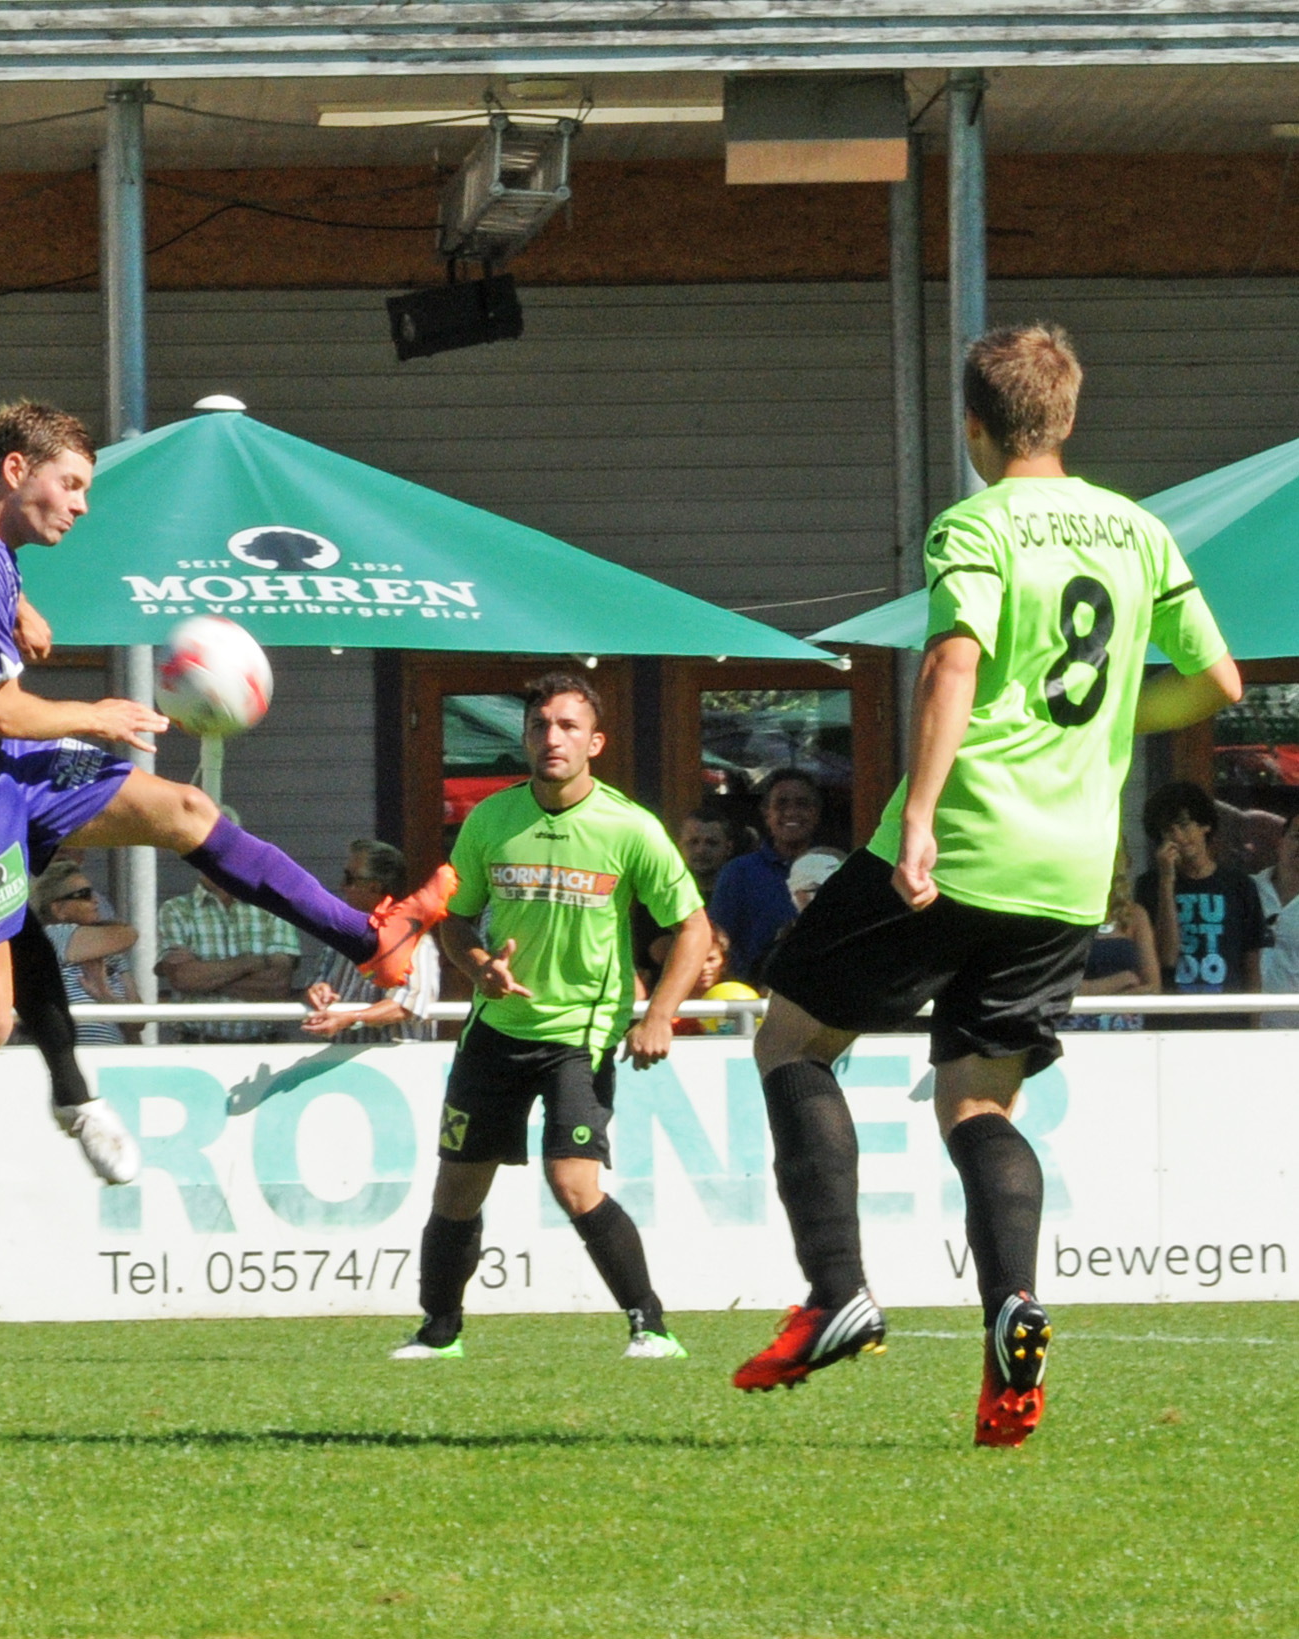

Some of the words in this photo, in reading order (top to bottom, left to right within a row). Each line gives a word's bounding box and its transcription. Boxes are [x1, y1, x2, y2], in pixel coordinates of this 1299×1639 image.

[1013, 513, 1045, 548] SC
[1048, 512, 1137, 551] FUSSACH
[176, 559, 232, 570] SEIT
[348, 561, 404, 573] 1834
[121, 574, 476, 608] MOHREN
[139, 603, 196, 616] Das
[207, 601, 406, 618] Vorarlberger
[420, 606, 483, 620] Bier
[1044, 575, 1115, 729] 8
[99, 1249, 183, 1295] Tel.
[207, 1245, 531, 1293] 05574/731
[1056, 1234, 1287, 1287] bewegen
